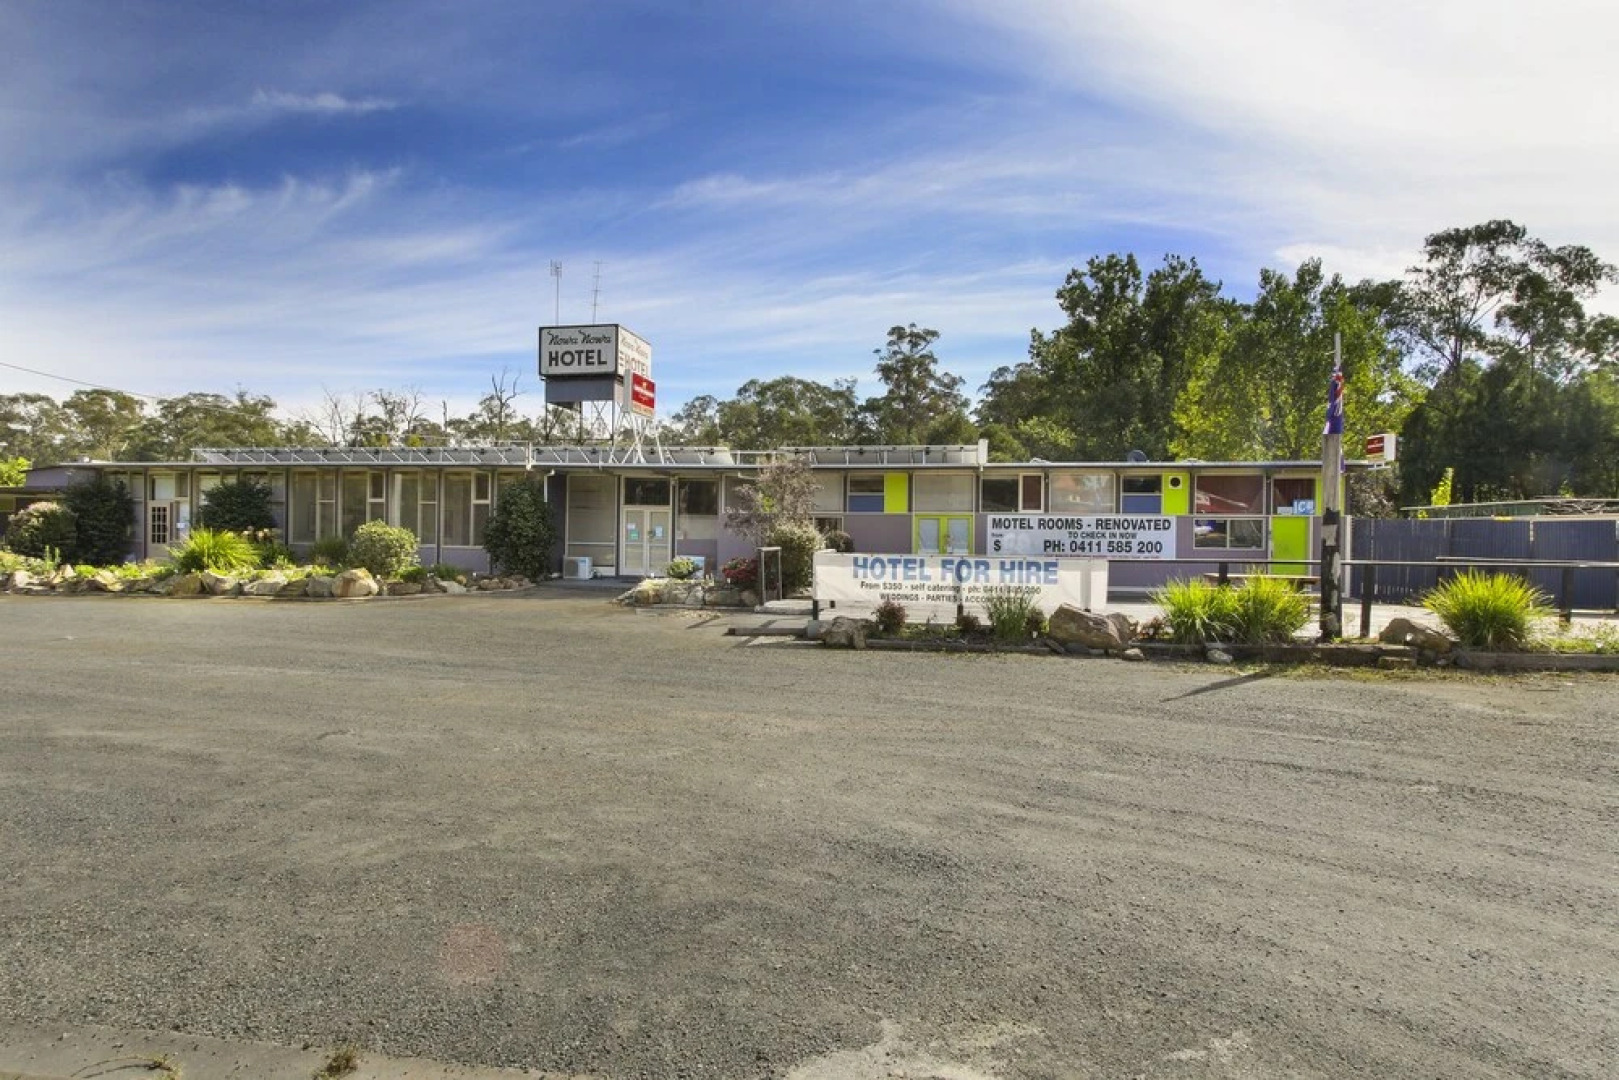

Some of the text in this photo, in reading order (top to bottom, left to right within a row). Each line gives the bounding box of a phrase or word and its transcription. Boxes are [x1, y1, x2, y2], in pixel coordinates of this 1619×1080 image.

[549, 349, 608, 367] HOTEL
[992, 518, 1033, 530] MOTEL
[1038, 518, 1083, 530] ROOMS
[1096, 519, 1172, 531] RENOVATED
[1044, 540, 1163, 554] PH: 0411 585 200
[852, 556, 1059, 584] HOTEL FOR HIRE
[861, 581, 880, 589] From
[911, 583, 925, 591] self
[927, 583, 960, 595] catering
[926, 594, 958, 603] PARTIES
